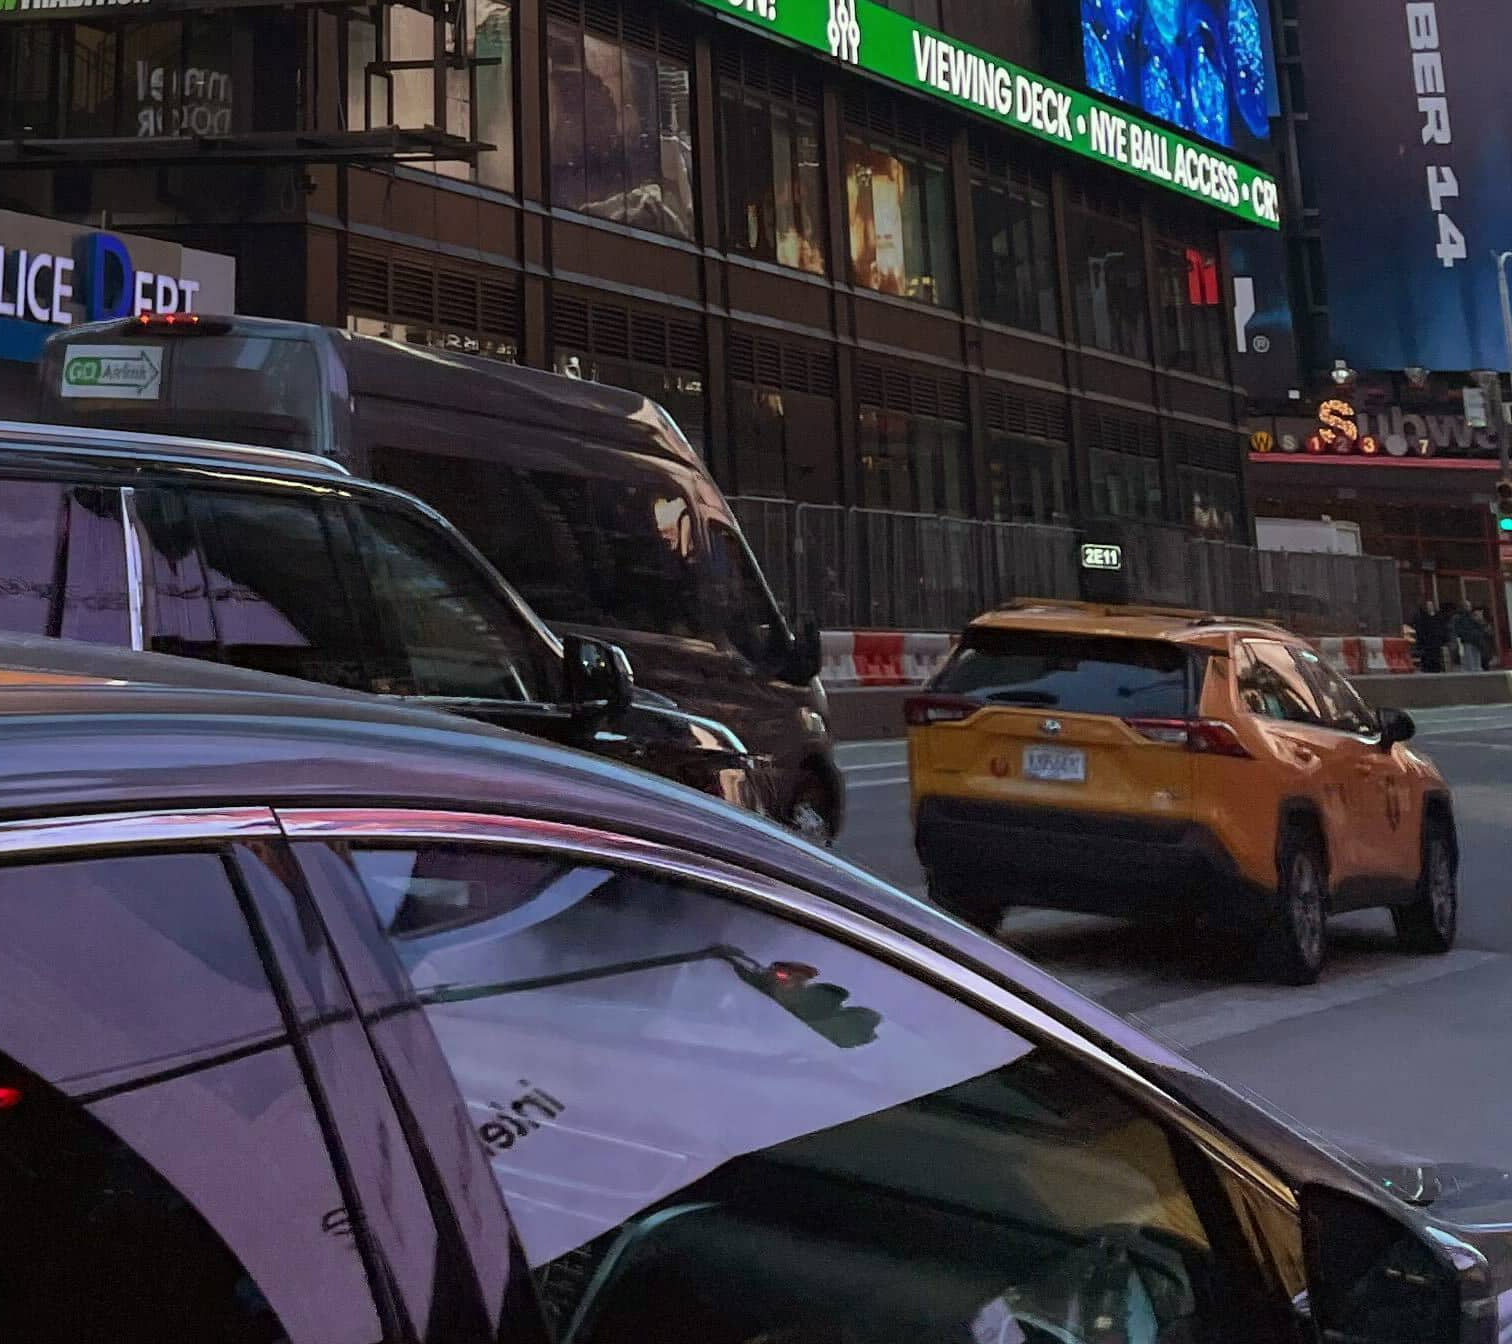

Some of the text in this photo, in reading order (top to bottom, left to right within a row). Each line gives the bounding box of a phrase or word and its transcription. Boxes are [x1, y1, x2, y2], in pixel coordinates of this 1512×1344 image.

[912, 29, 1013, 116] VIEWING
[1015, 76, 1074, 143] DECK
[1089, 106, 1128, 164] NYE
[1129, 123, 1173, 181] BALL
[1173, 143, 1239, 208] ACCESS
[1426, 165, 1468, 268] 14
[1085, 548, 1118, 565] 2E11
